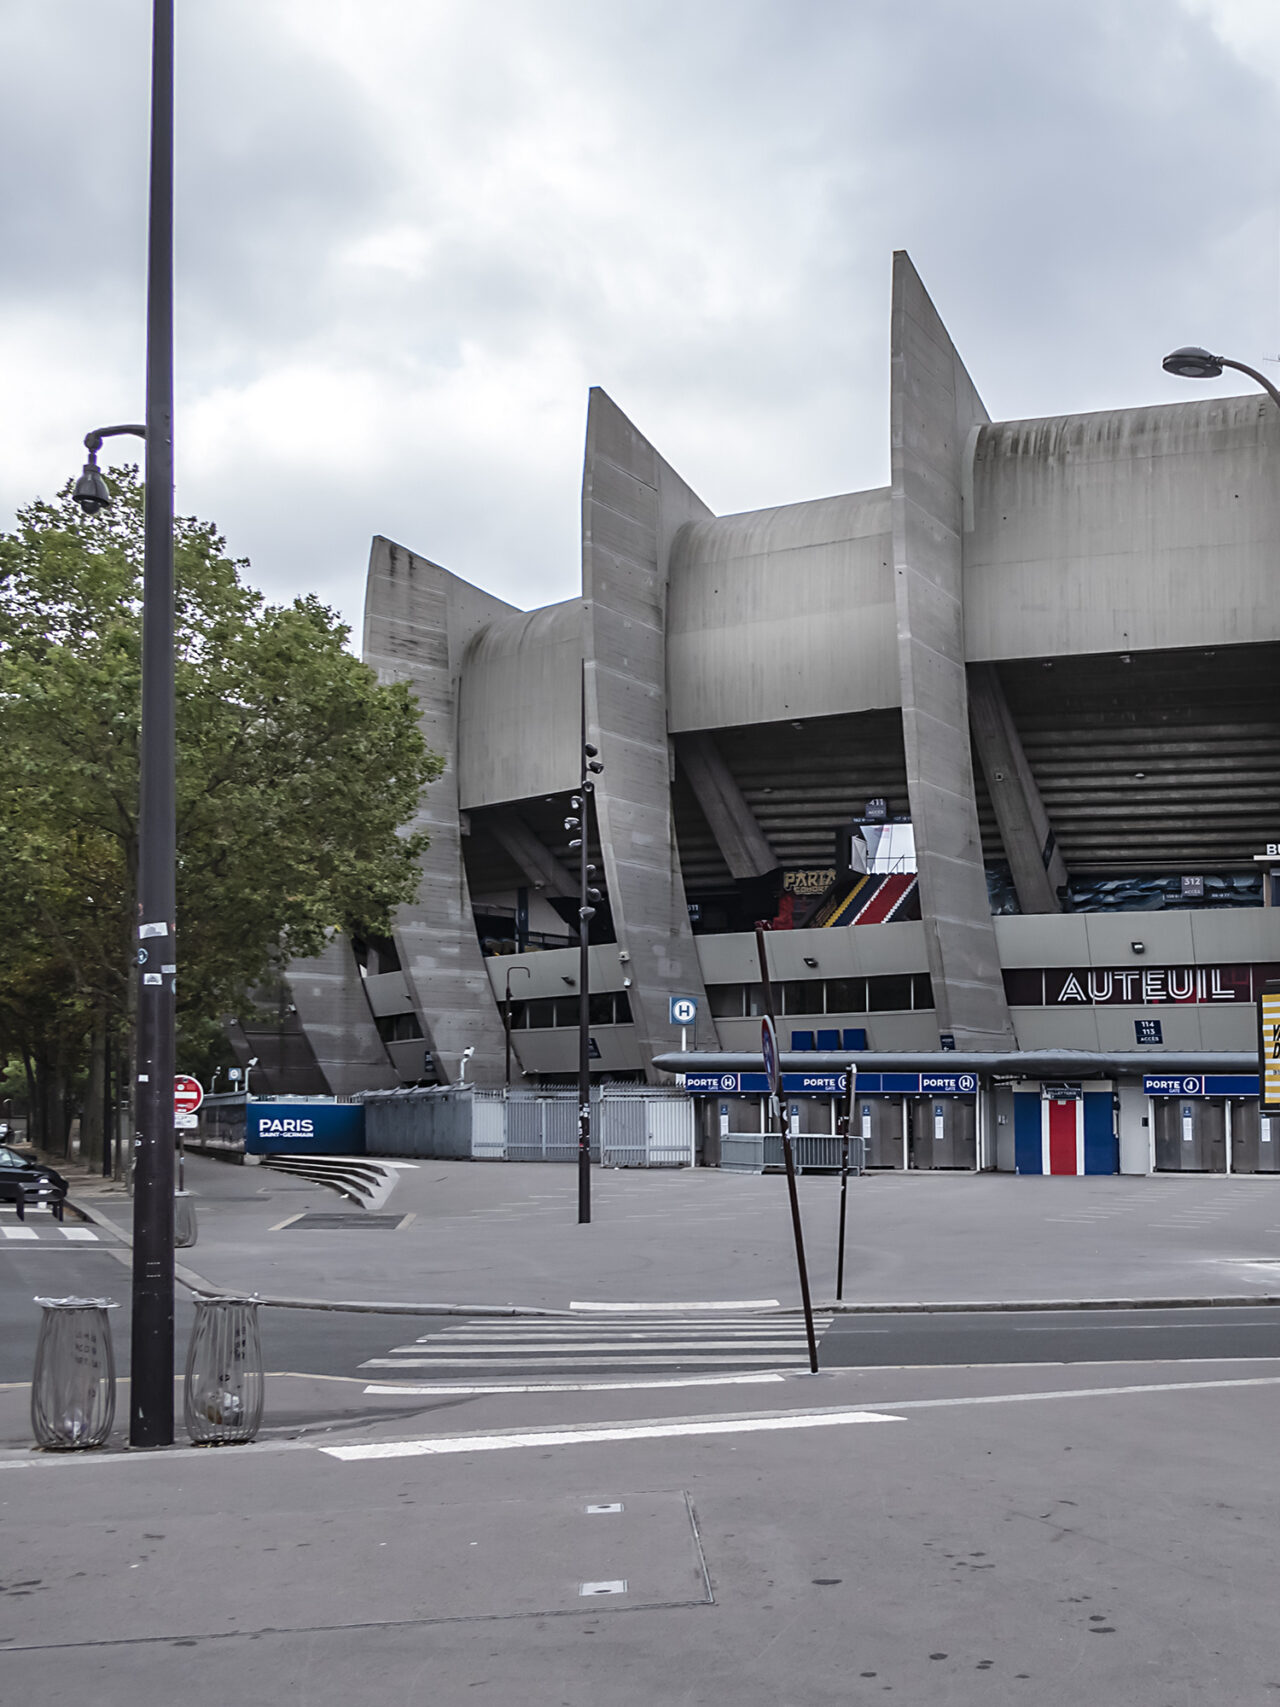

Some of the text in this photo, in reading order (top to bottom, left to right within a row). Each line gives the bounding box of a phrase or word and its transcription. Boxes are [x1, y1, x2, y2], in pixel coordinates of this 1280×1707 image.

[1057, 969, 1235, 1001] AUTEUIL
[803, 1078, 836, 1086] PORTE
[923, 1079, 956, 1087] PORTE
[1146, 1081, 1180, 1089] PORTE
[259, 1119, 314, 1132] PARIS
